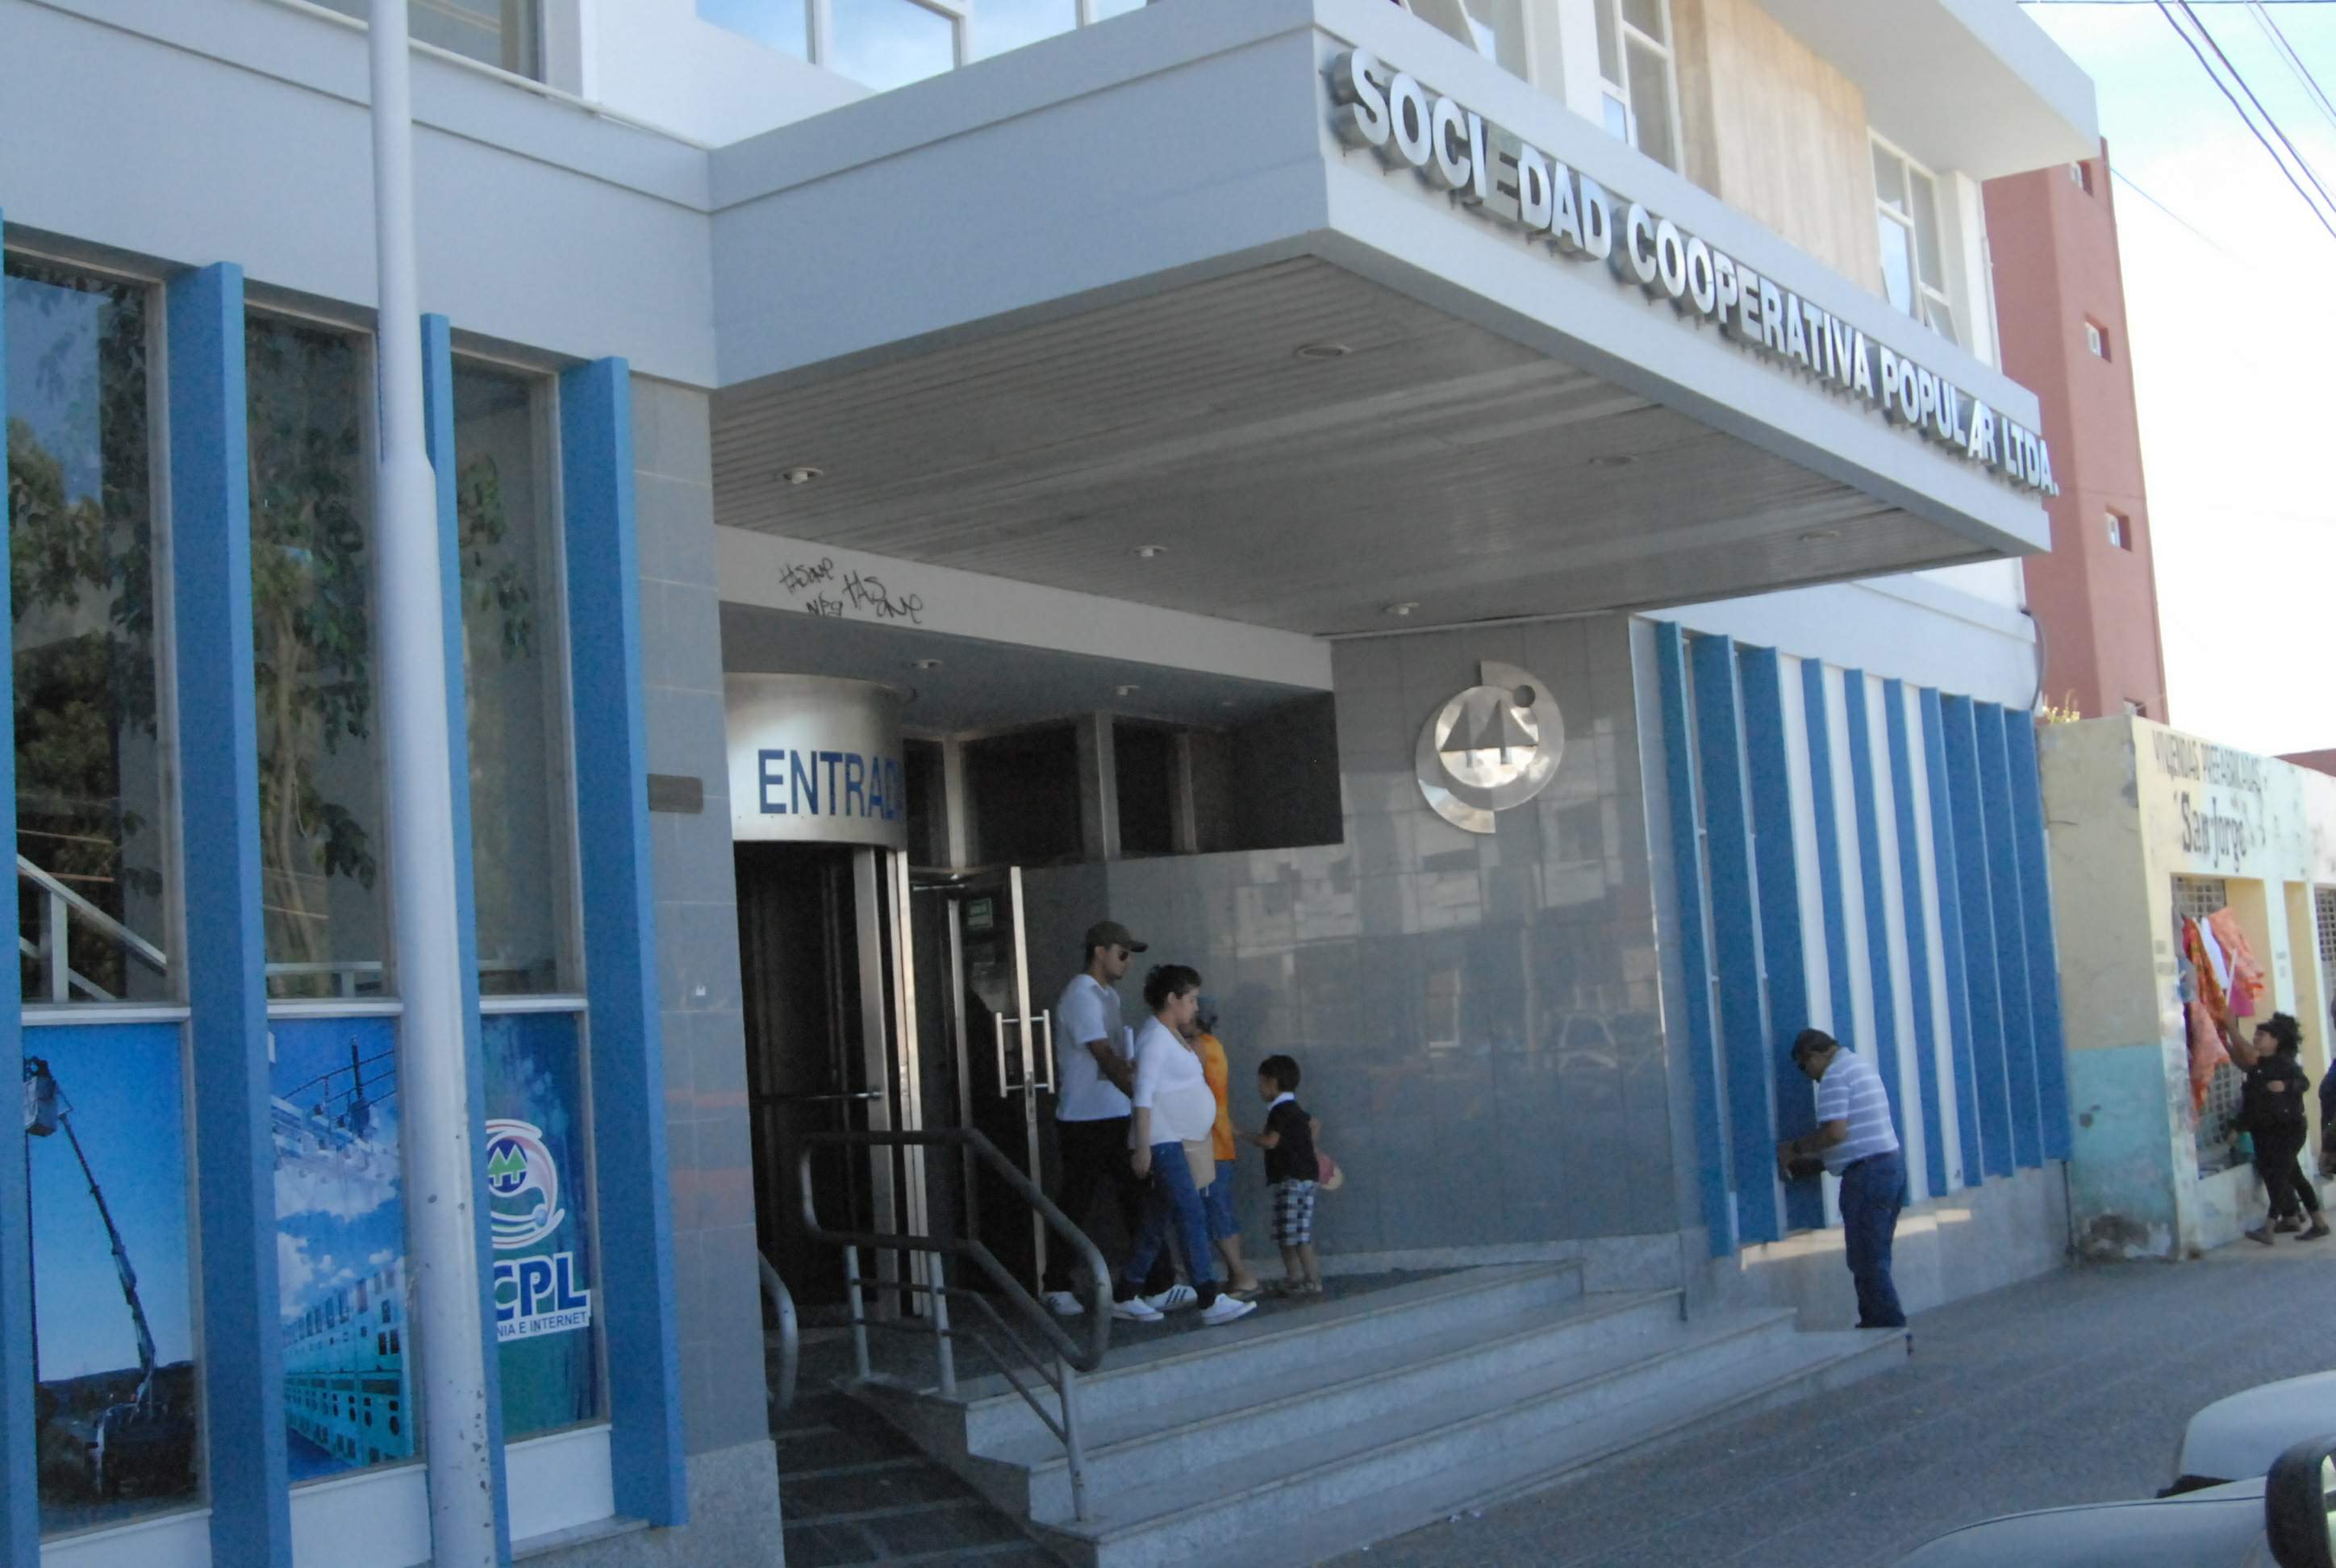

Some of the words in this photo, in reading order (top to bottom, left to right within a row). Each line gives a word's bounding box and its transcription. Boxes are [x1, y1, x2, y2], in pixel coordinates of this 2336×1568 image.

[1342, 46, 1612, 260] SOCIEDAD
[1625, 202, 1874, 398] COOPERATIVA
[1879, 344, 1997, 465] POPULAR
[519, 1321, 527, 1334] E
[530, 1311, 587, 1332] INTERNET
